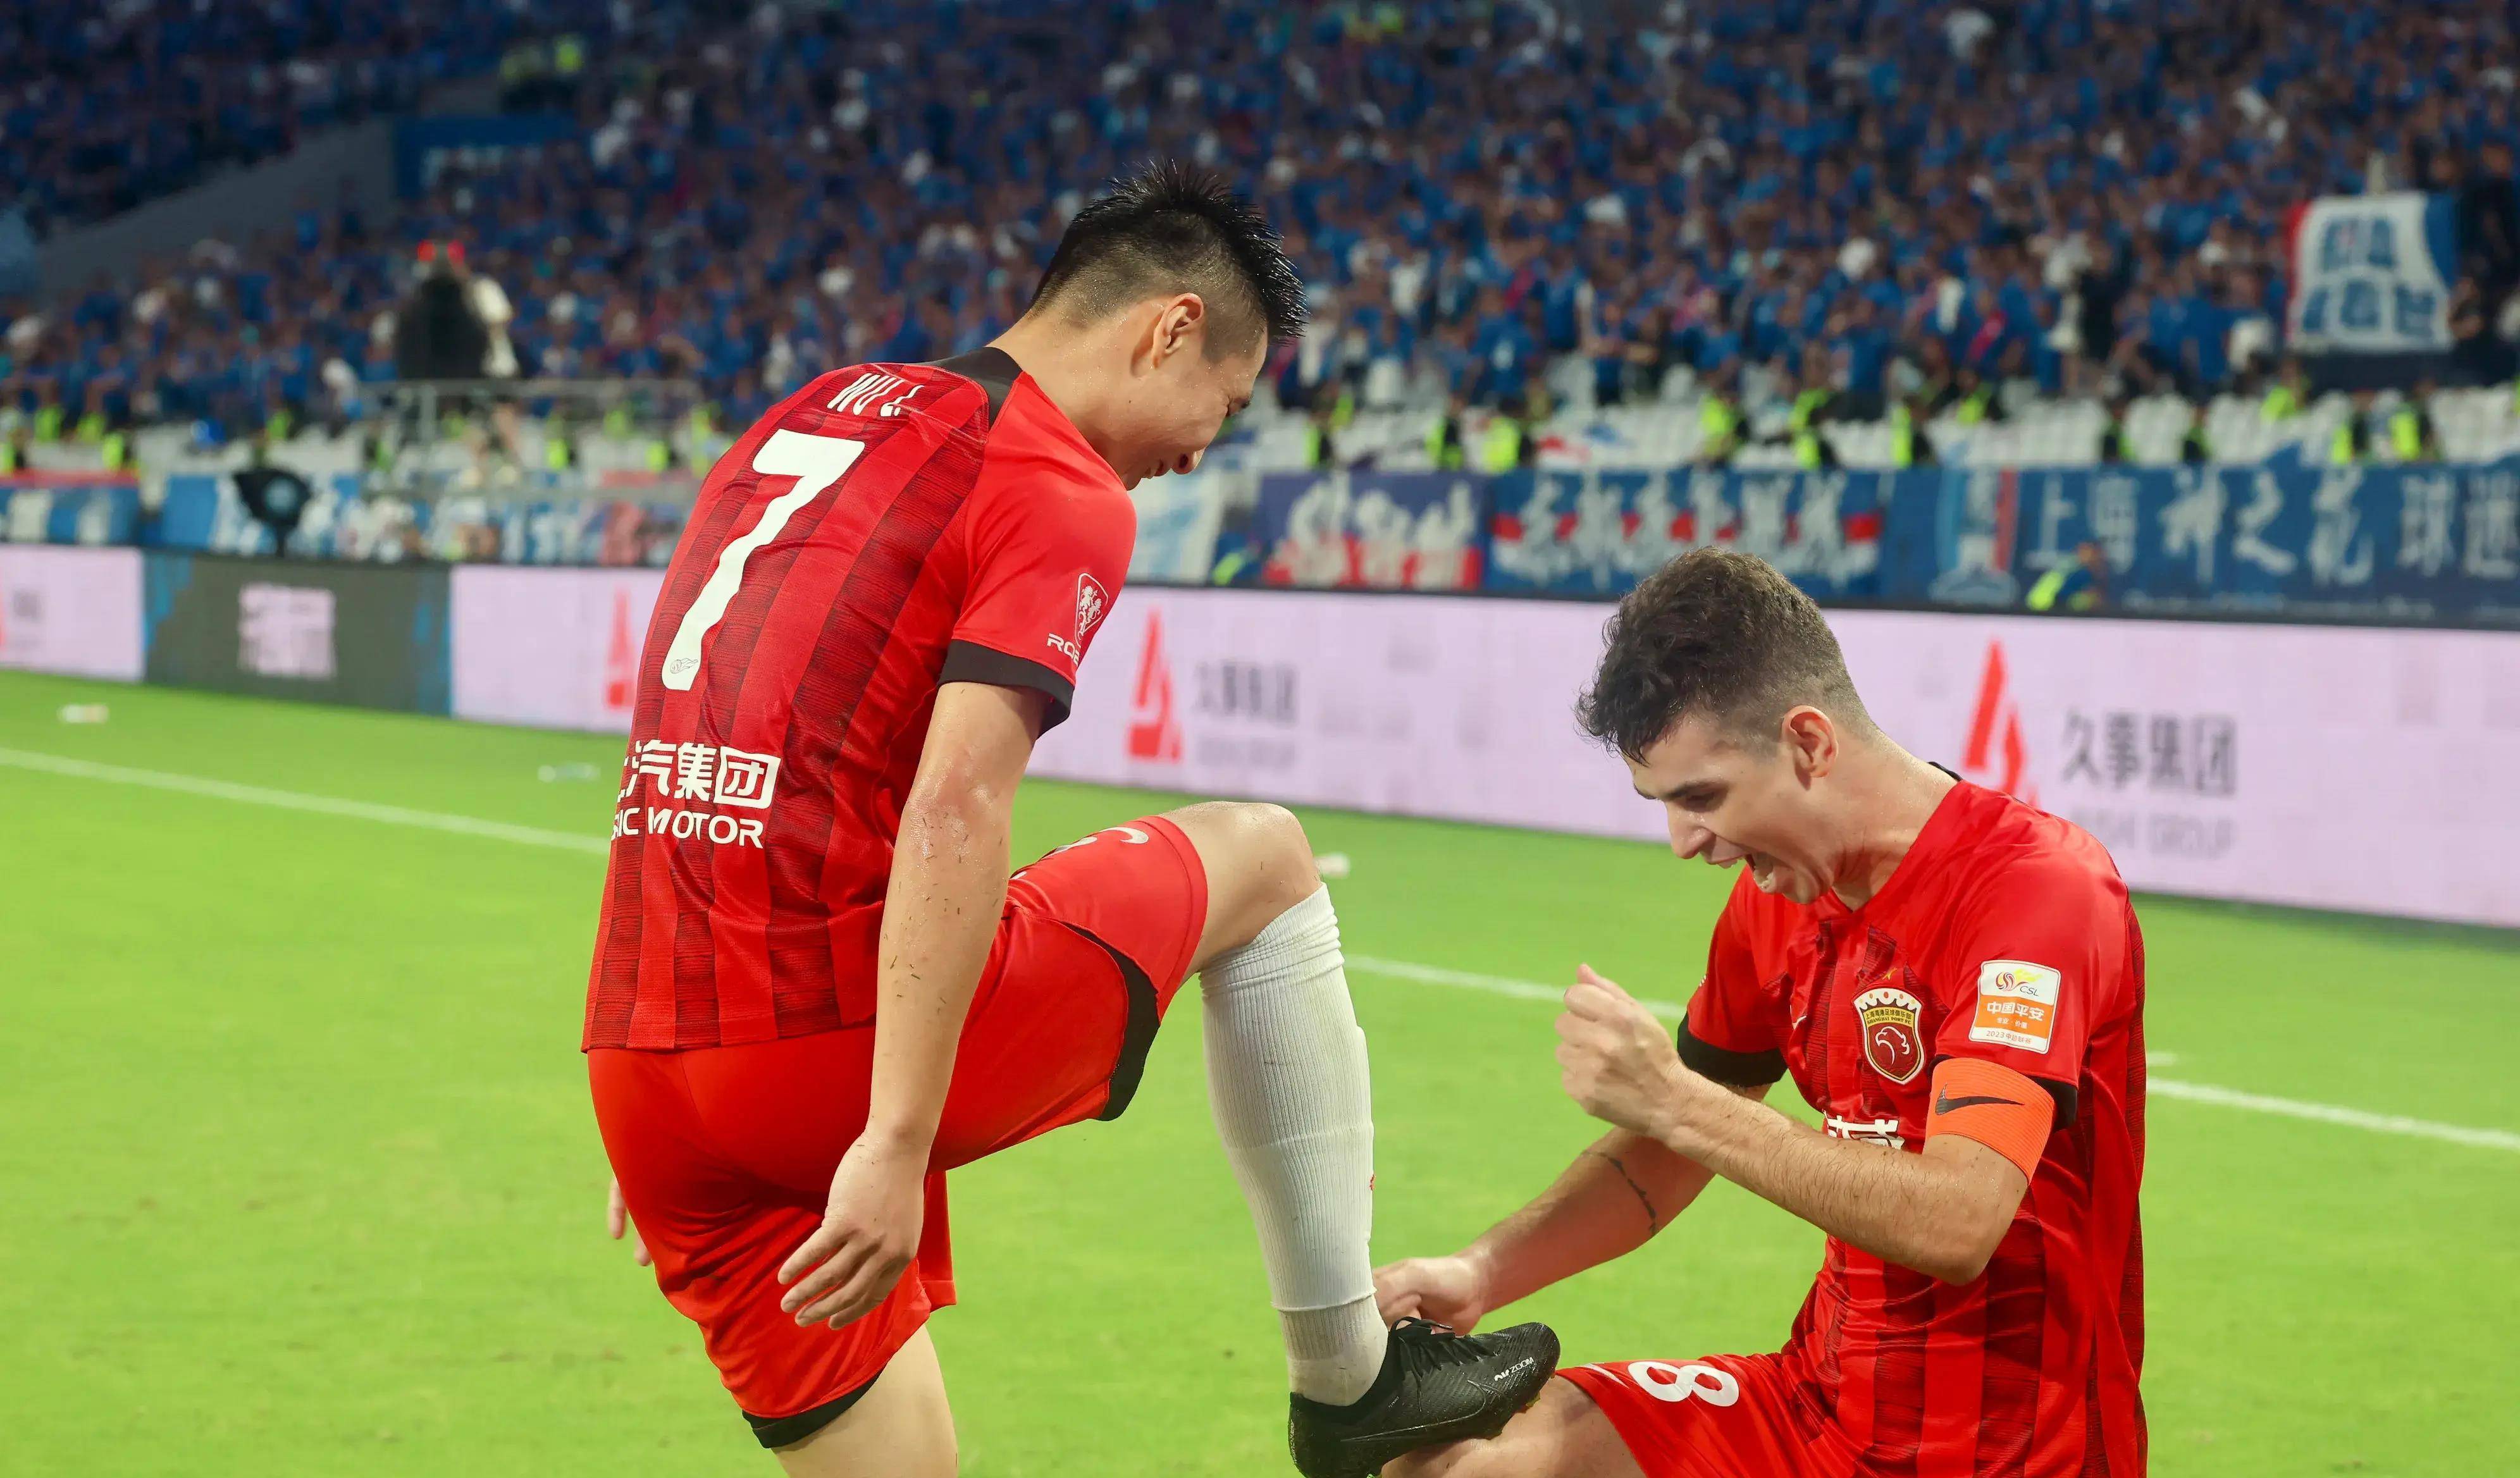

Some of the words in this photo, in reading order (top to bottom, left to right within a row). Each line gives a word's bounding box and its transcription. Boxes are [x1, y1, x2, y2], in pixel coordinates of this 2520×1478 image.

[662, 429, 865, 691] 7
[617, 739, 781, 809] 汽集团
[648, 806, 763, 849] MOTOR
[1987, 1001, 2045, 1021] 中国平安
[2020, 985, 2039, 997] CSL
[1509, 1357, 1534, 1373] ZOOM
[1628, 1361, 1739, 1407] 8
